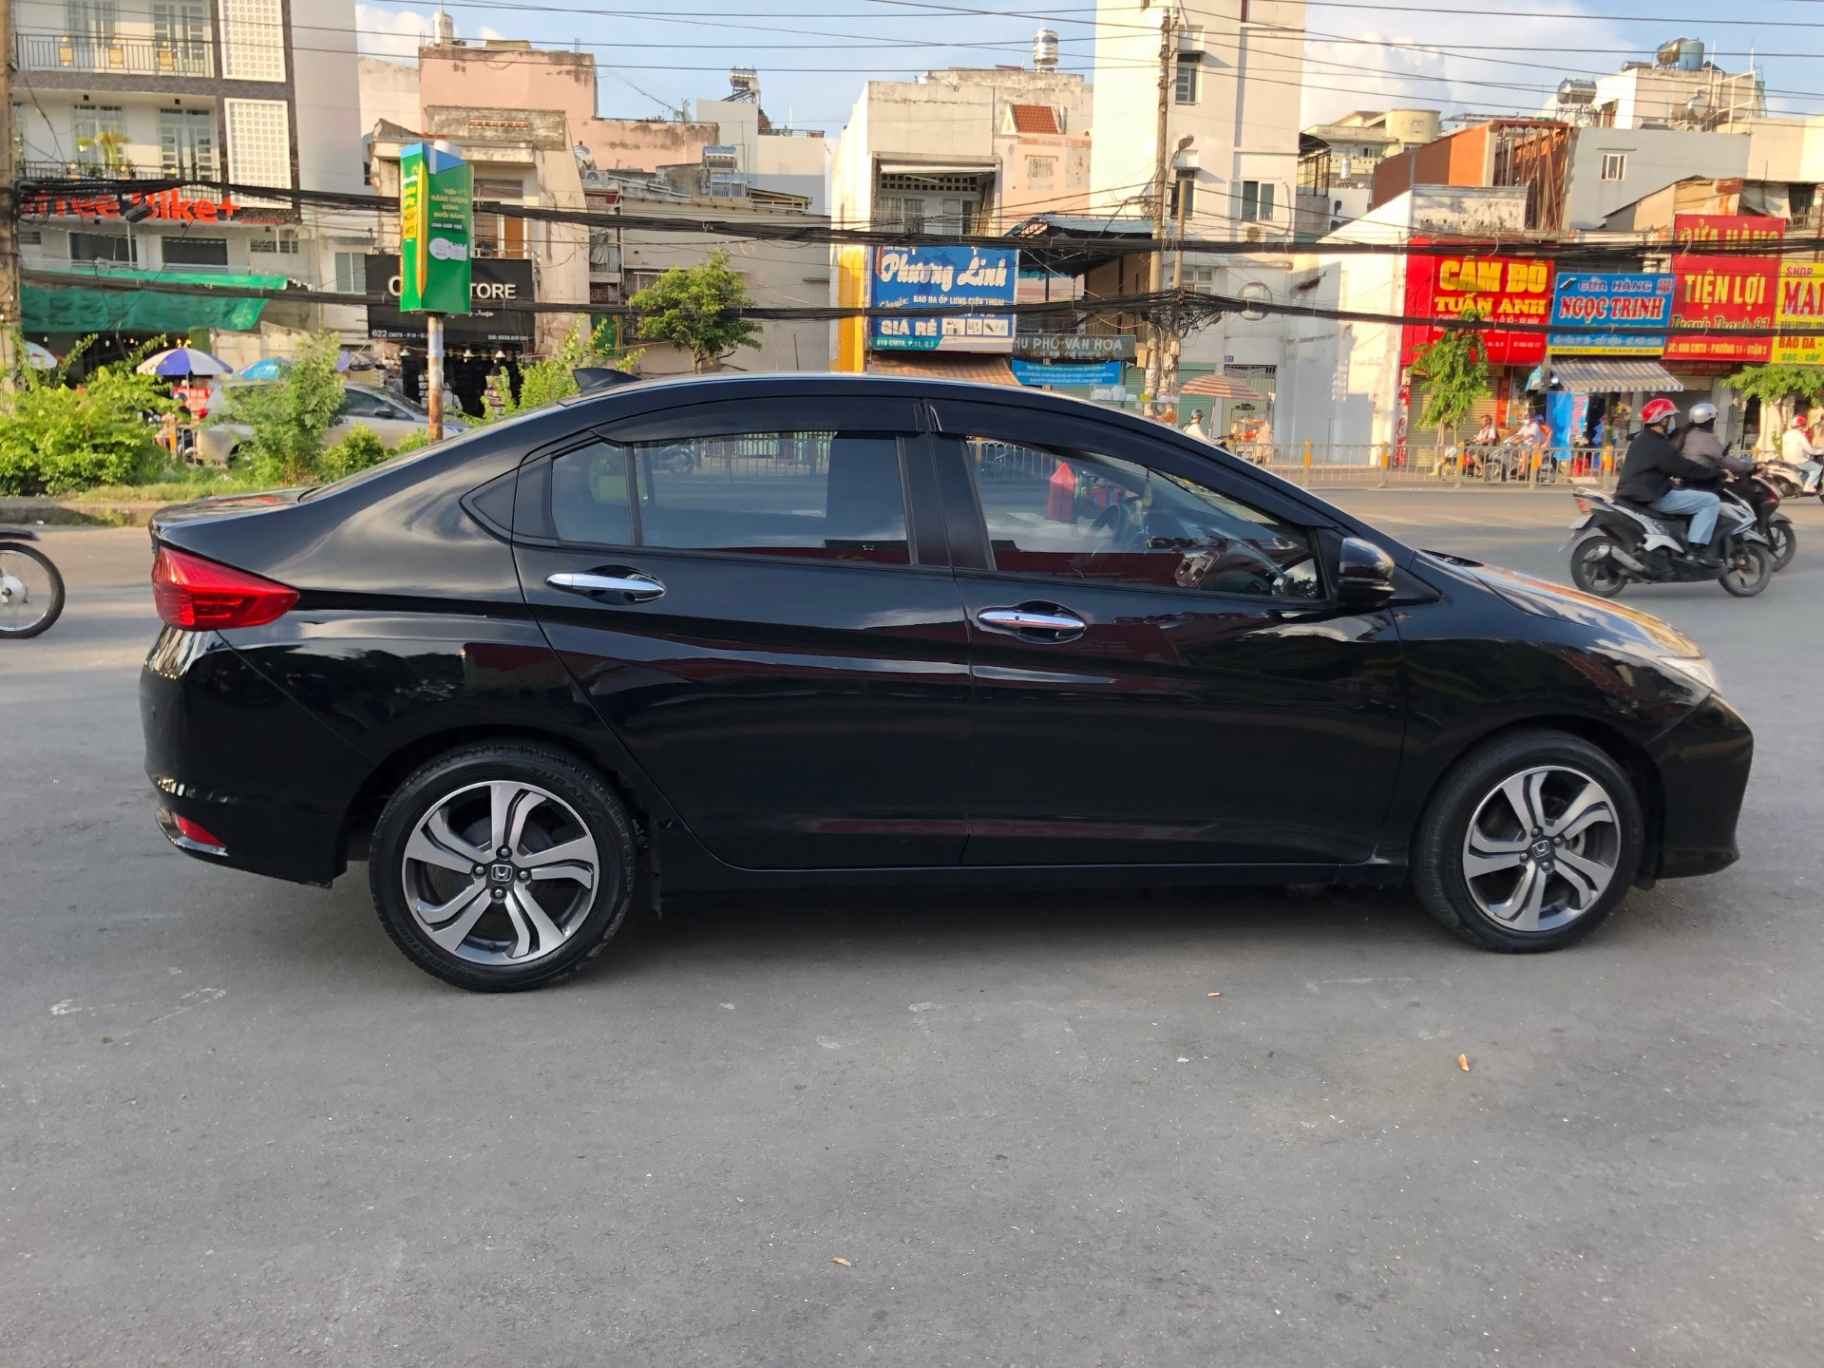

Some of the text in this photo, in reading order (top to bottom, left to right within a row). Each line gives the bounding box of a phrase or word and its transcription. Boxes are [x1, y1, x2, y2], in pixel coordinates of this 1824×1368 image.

[957, 257, 1007, 287] Linh
[1786, 266, 1814, 277] SHOP
[470, 283, 516, 299] TORE
[1578, 276, 1653, 292] CỬA HÀNG
[1684, 270, 1766, 311] TIỆN LỢI
[913, 295, 927, 303] BAO
[928, 295, 938, 303] DA
[1497, 298, 1547, 314] ANH
[1559, 296, 1665, 324] NGỌC TRINH
[371, 329, 388, 337] 622
[881, 317, 938, 336] GIÁ RẺ
[1778, 335, 1816, 350] BAO DA
